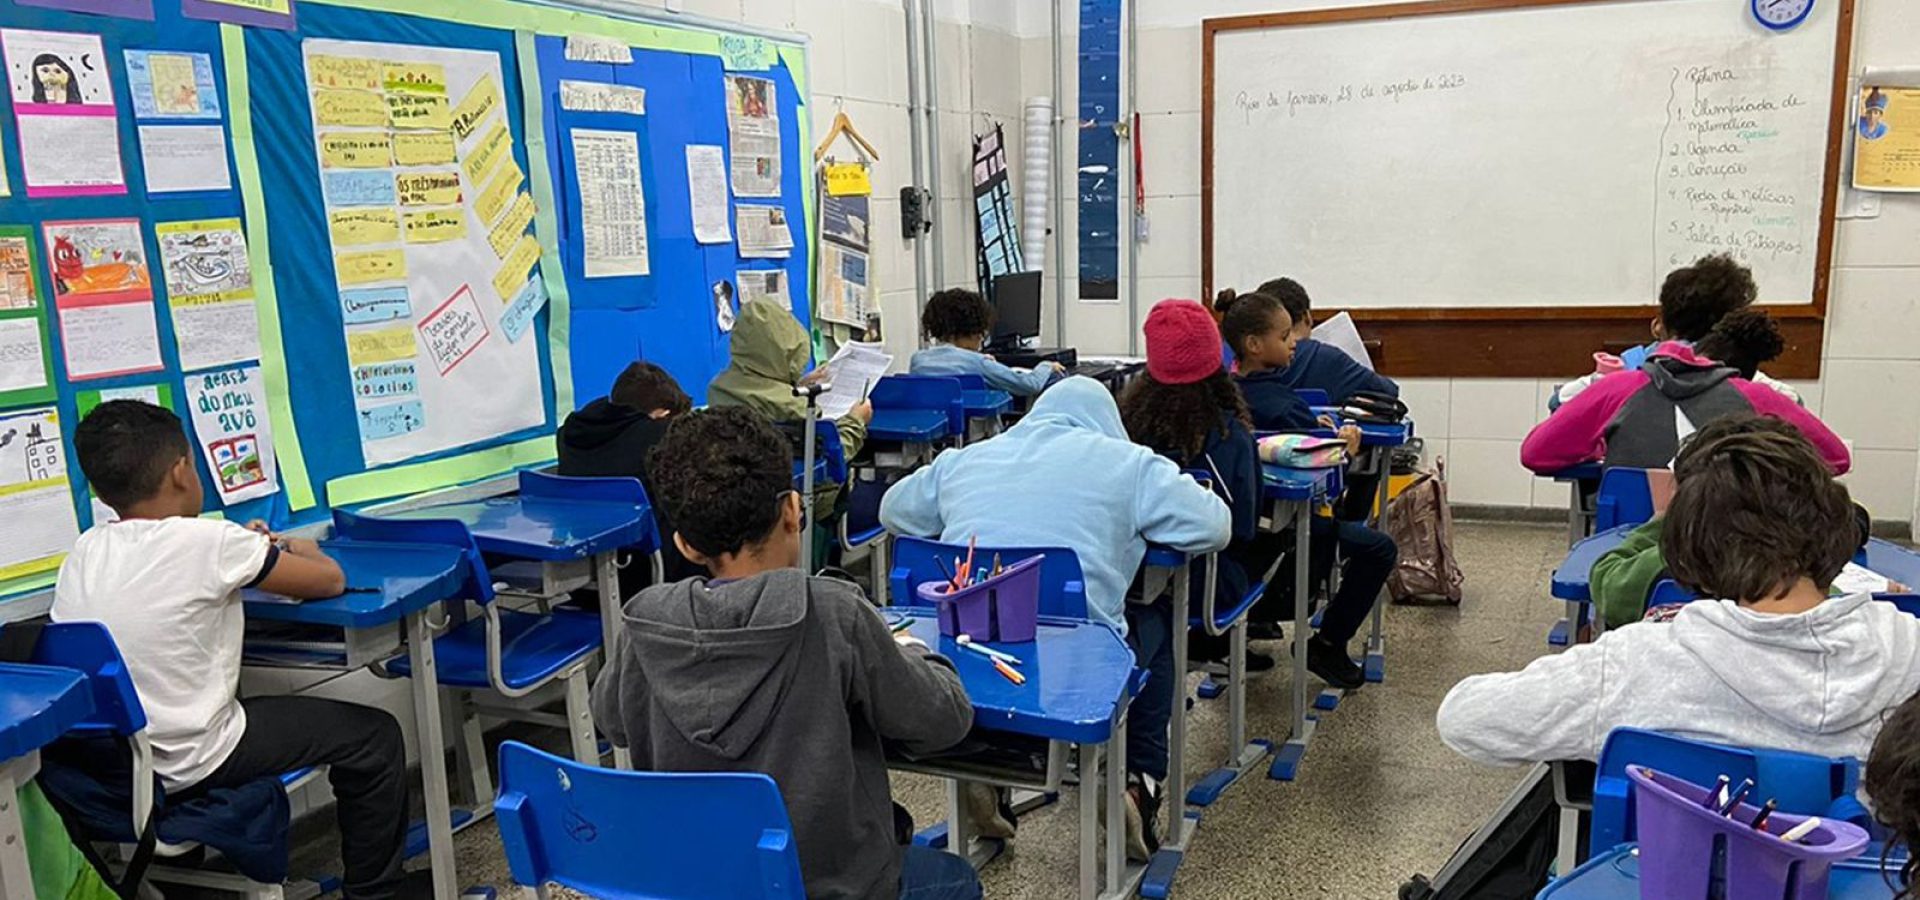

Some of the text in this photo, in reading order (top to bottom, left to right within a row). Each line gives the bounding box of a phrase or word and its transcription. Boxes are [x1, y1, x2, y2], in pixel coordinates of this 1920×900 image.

[1235, 89, 1260, 125] Rio
[1267, 91, 1279, 106] de
[1360, 84, 1374, 98] de
[1782, 93, 1805, 108] de
[198, 390, 220, 414] do
[218, 408, 257, 433] avô
